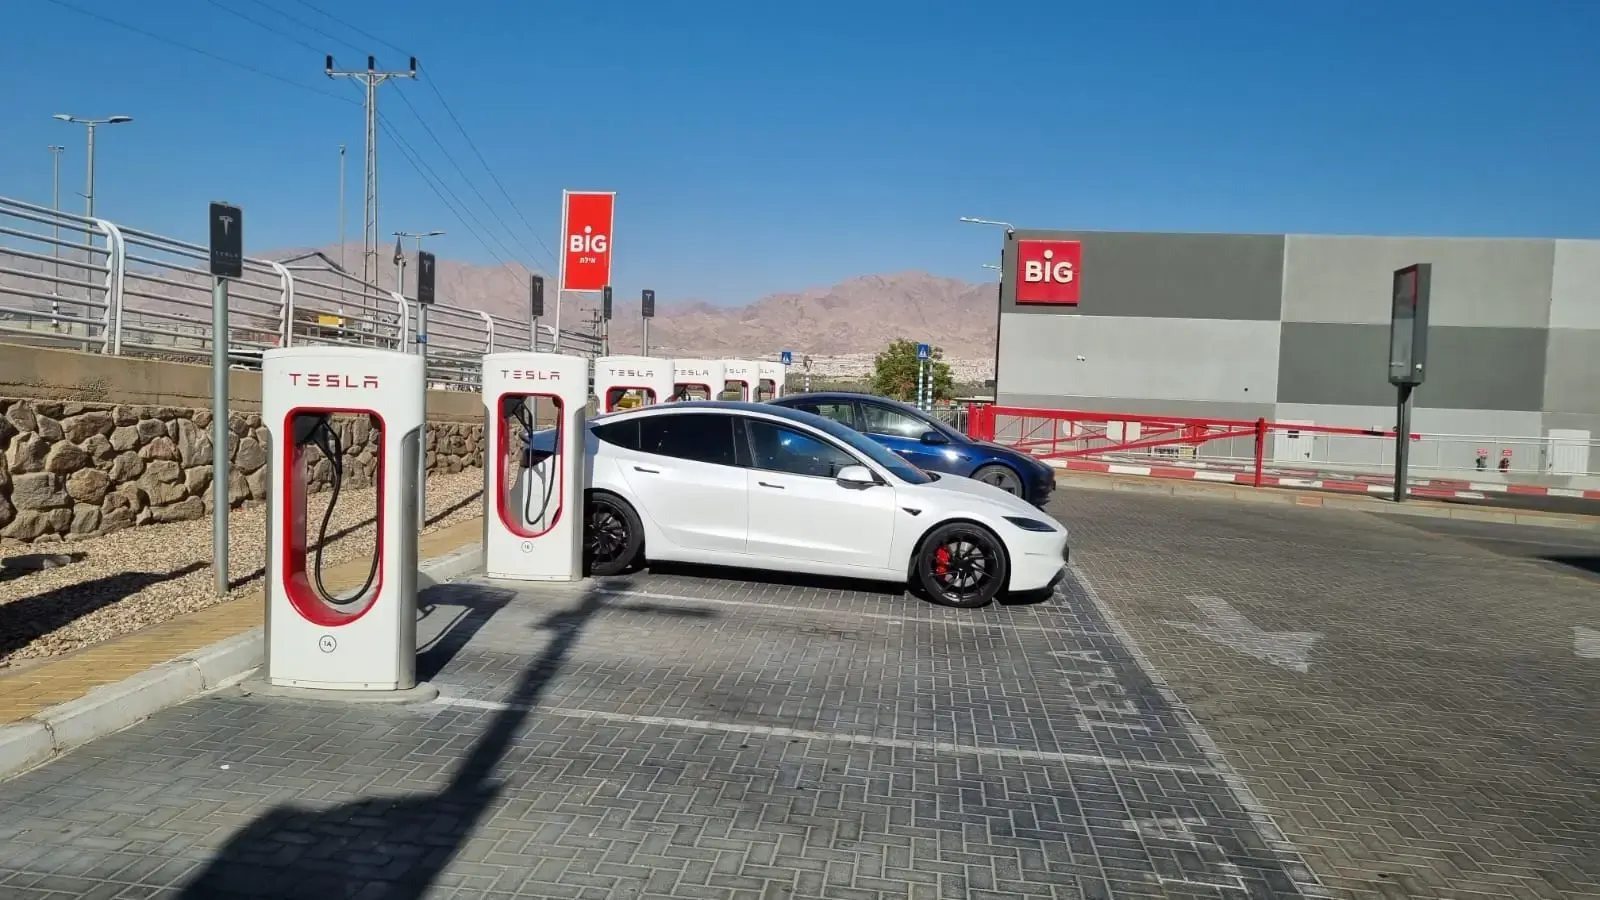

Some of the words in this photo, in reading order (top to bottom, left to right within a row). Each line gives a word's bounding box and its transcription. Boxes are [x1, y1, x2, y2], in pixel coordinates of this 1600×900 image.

[500, 369, 561, 381] TESLA
[609, 369, 654, 378] TESLA
[288, 373, 378, 389] TESLA
